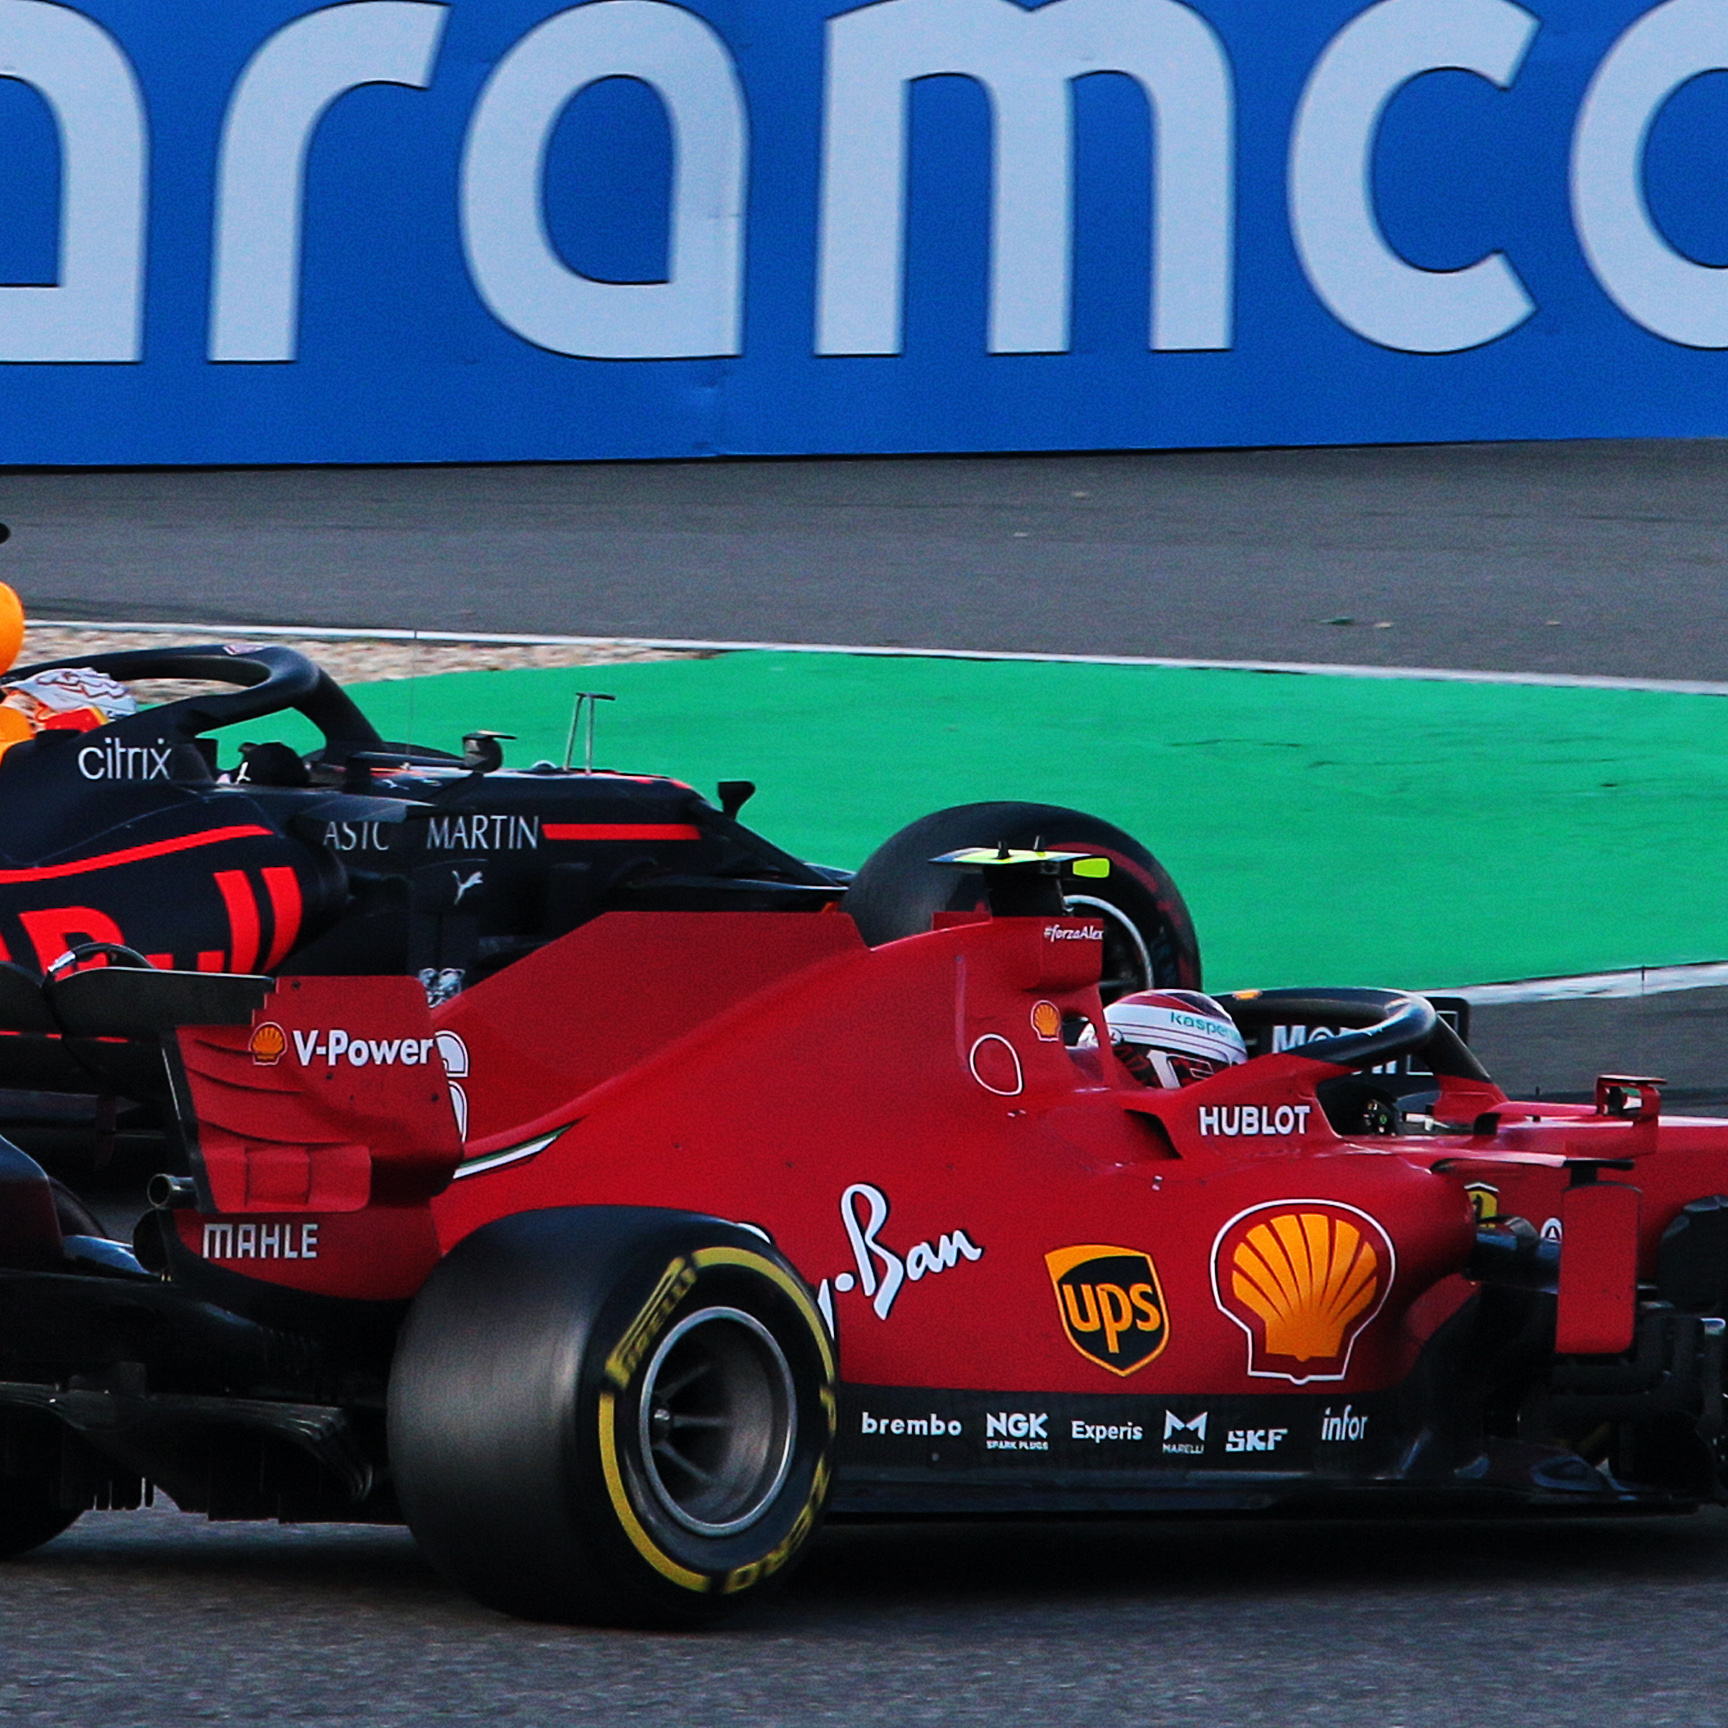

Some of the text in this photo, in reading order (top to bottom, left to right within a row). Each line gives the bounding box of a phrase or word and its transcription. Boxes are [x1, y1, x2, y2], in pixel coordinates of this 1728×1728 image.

[77, 738, 172, 780] citrix
[426, 815, 539, 850] MARTIN
[292, 1029, 435, 1067] V-Power
[1198, 1104, 1311, 1136] HUBLOT
[202, 1223, 319, 1259] MAHLE
[1062, 1283, 1161, 1353] ups
[861, 1411, 962, 1436] brembo
[986, 1411, 1049, 1438] NGK
[1071, 1420, 1143, 1444] Experis
[1321, 1404, 1369, 1440] infor
[986, 1440, 1017, 1450] SPARK
[1162, 1442, 1205, 1454] MARELLI
[1225, 1428, 1288, 1452] SKF
